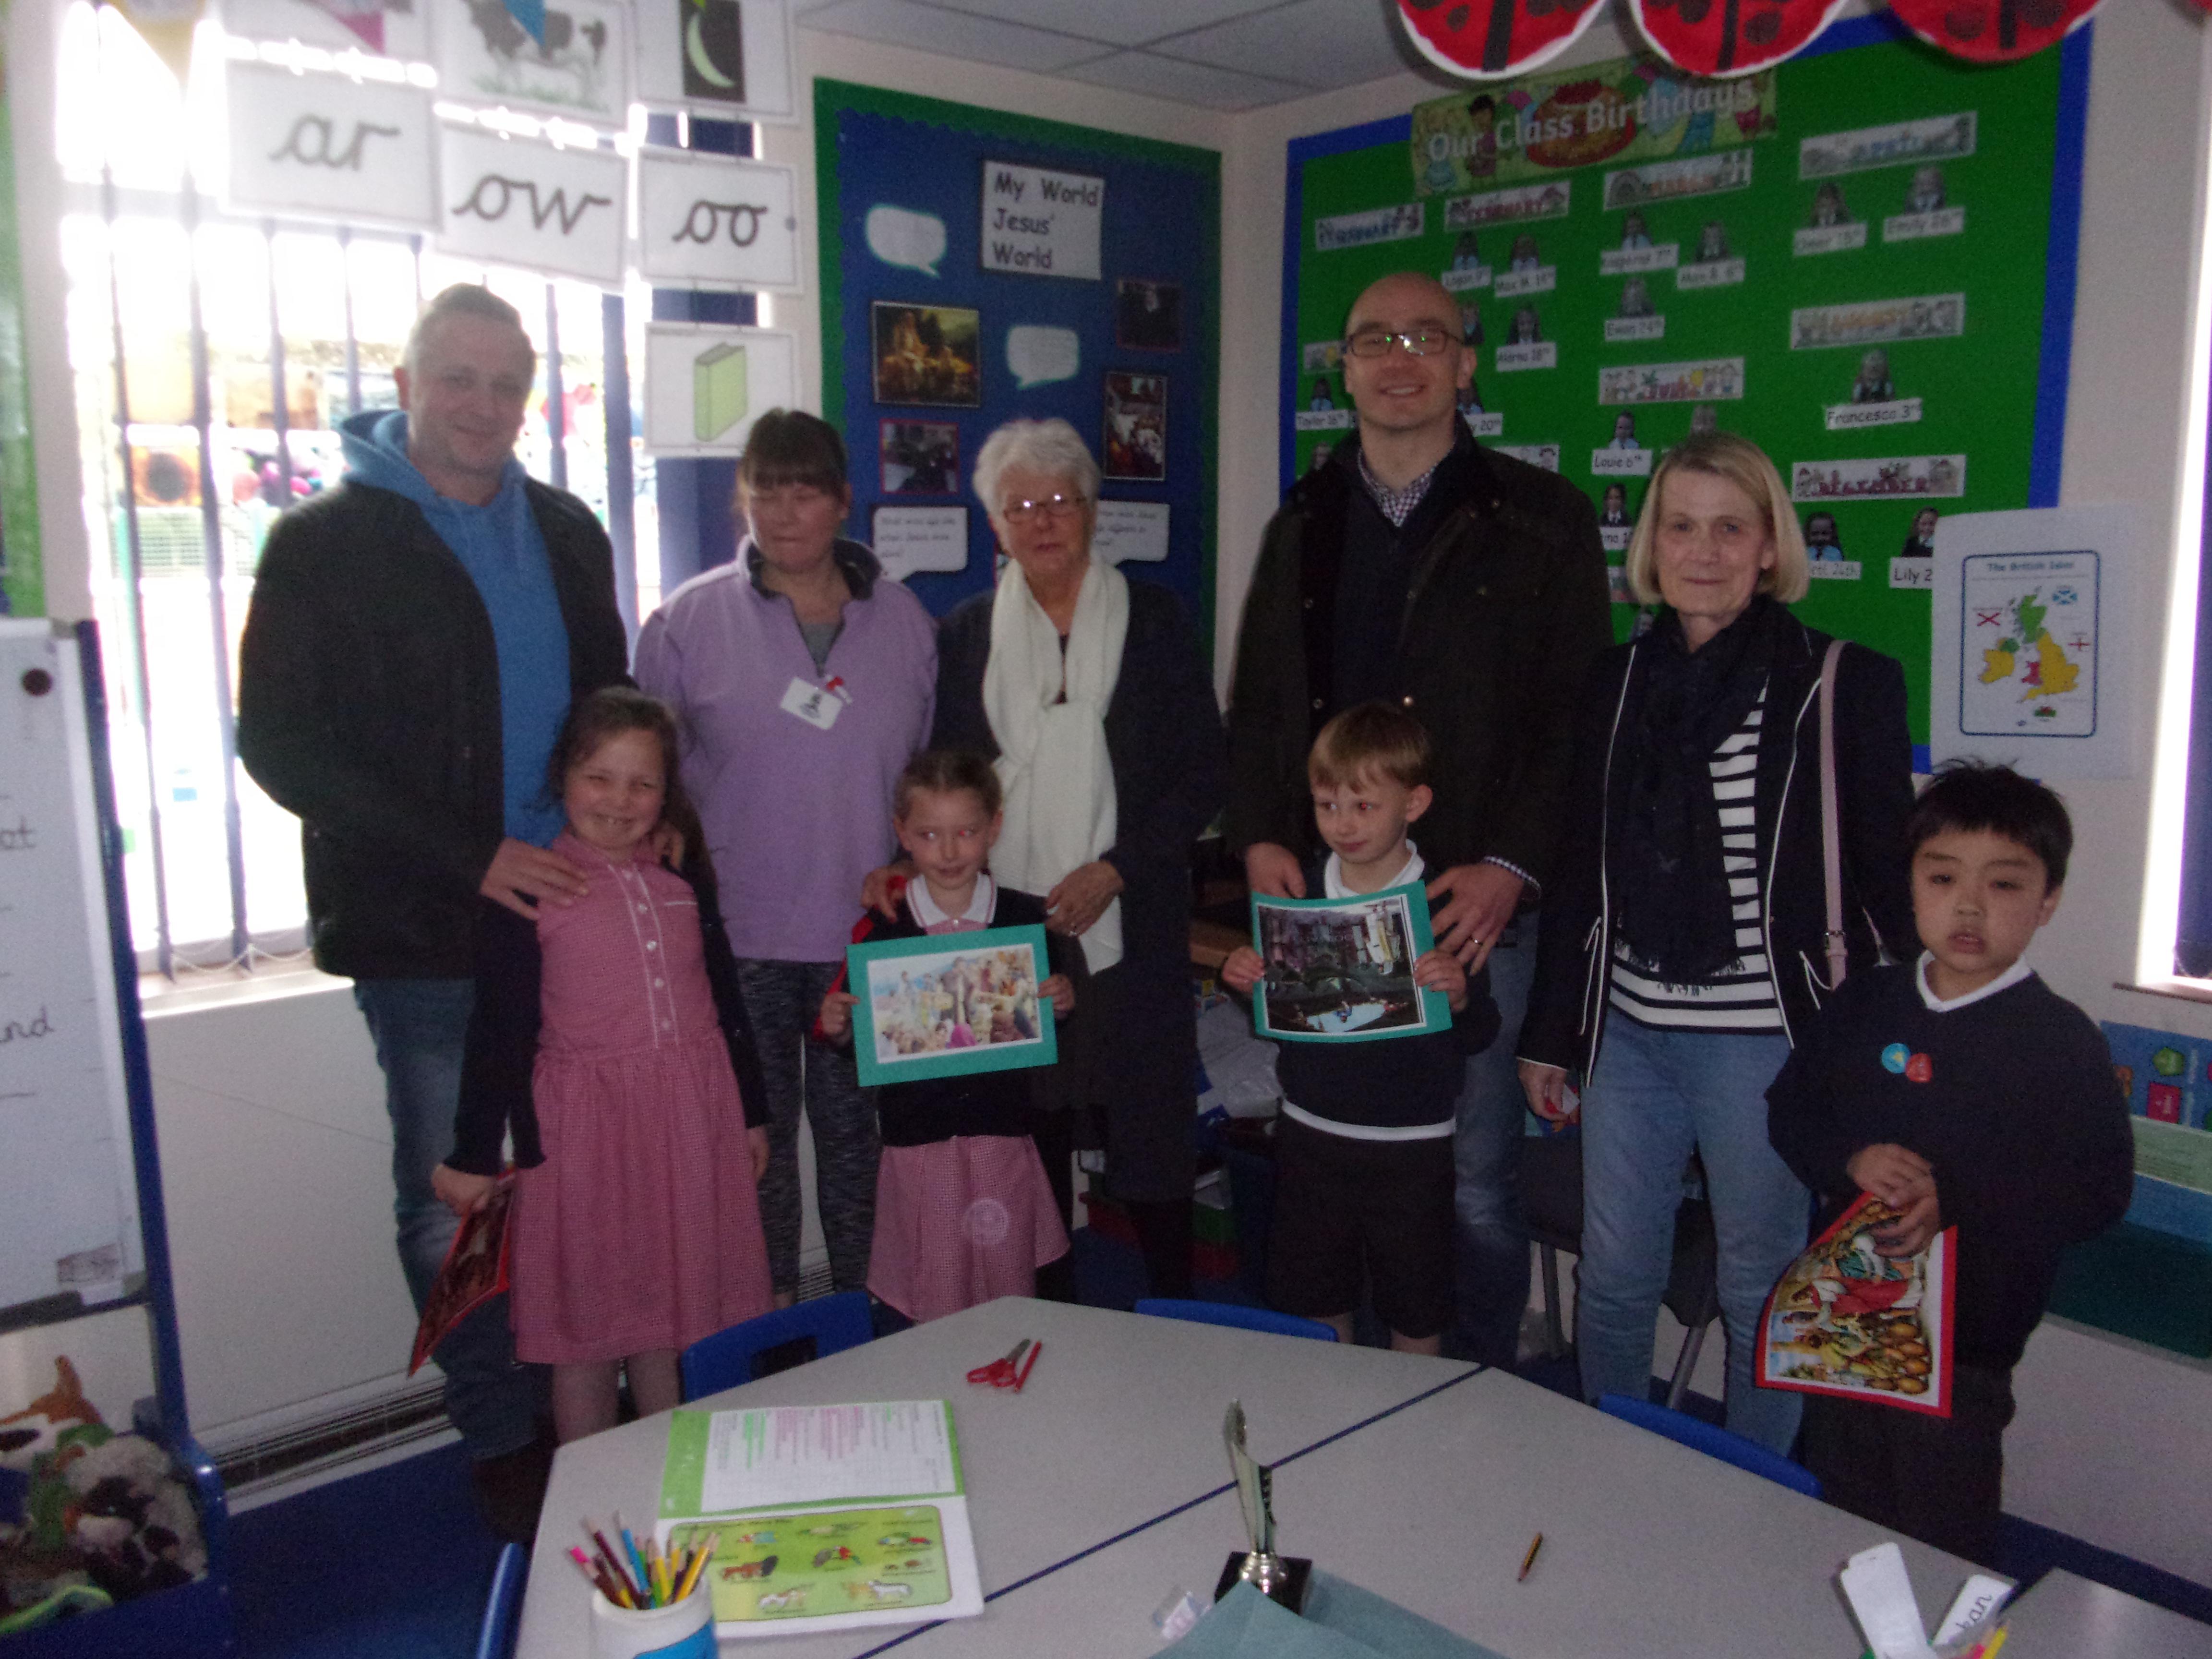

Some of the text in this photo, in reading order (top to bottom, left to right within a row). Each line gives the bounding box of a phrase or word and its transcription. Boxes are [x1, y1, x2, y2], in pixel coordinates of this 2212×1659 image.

[1429, 79, 1756, 162] Our Class Birthdays
[269, 114, 401, 171] ar
[452, 174, 612, 236] ow
[995, 171, 1100, 207] My World
[673, 199, 768, 248] oo
[993, 207, 1055, 235] Jesus'
[992, 241, 1052, 269] World
[1894, 567, 1920, 584] Lily
